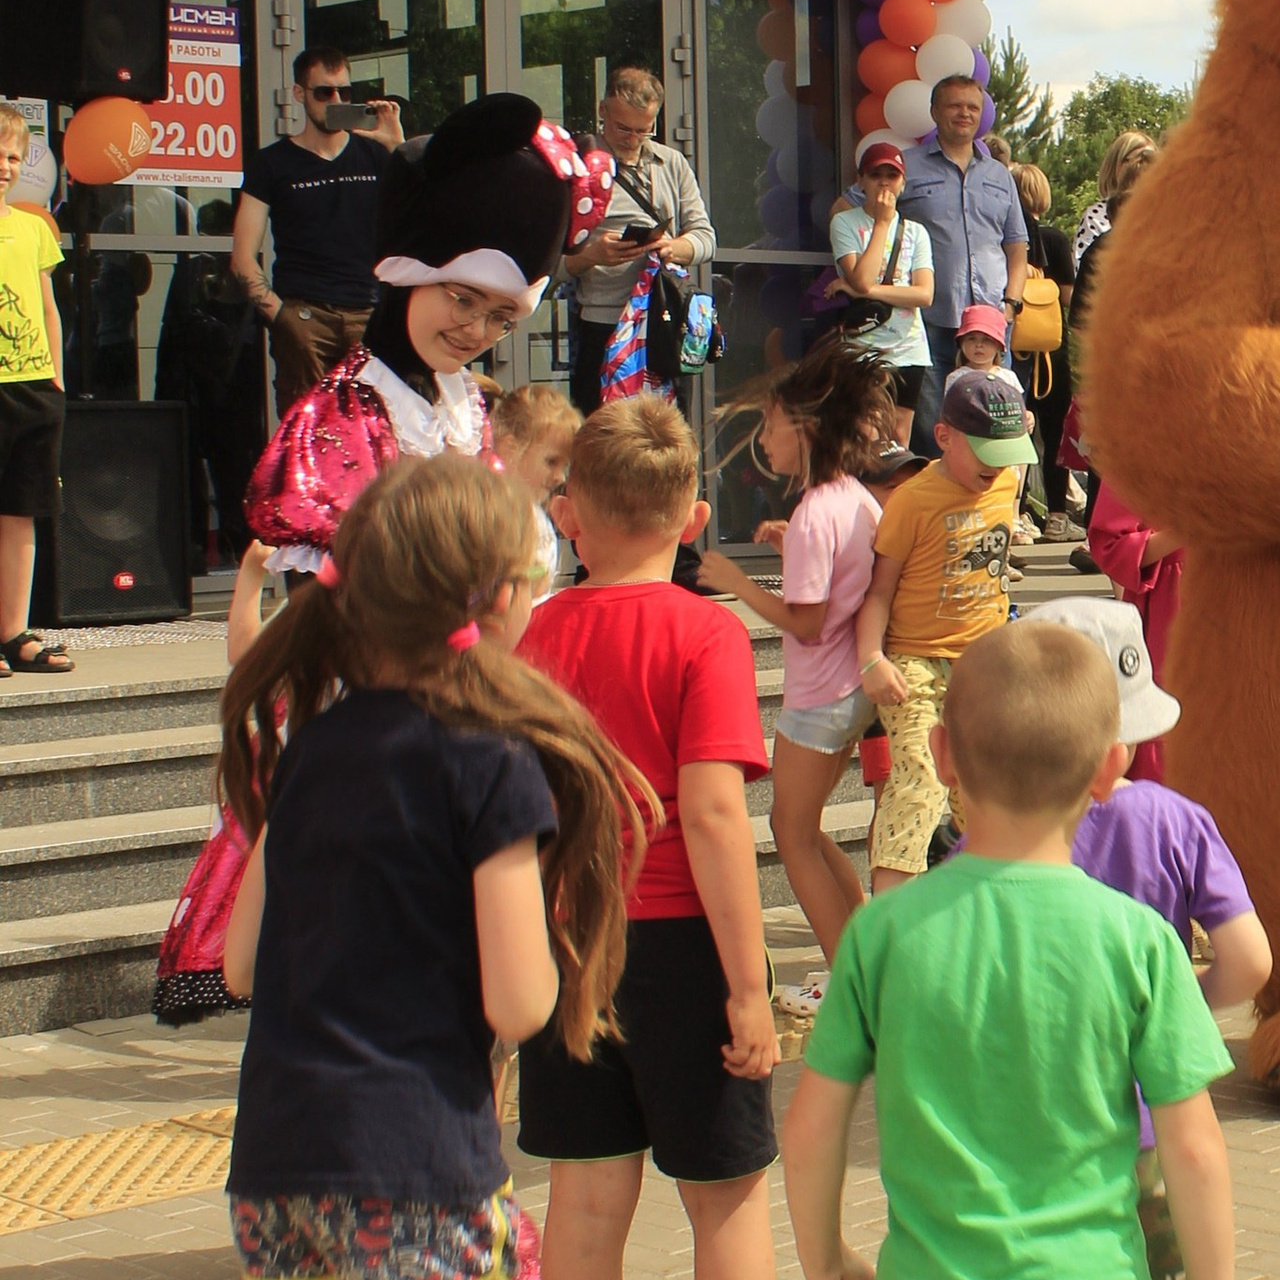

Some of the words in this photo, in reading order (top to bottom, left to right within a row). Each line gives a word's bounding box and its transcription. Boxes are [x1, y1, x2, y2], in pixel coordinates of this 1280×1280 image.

[170, 7, 236, 26] исман
[177, 45, 221, 57] РАБОТЫ
[149, 122, 236, 158] 22.00
[136, 172, 222, 183] www.tc-talisman.ru
[291, 179, 327, 190] TOMMY
[945, 509, 987, 532] ONE
[945, 531, 995, 557] STEP
[943, 559, 972, 579] UP
[939, 579, 998, 602] LEVEL
